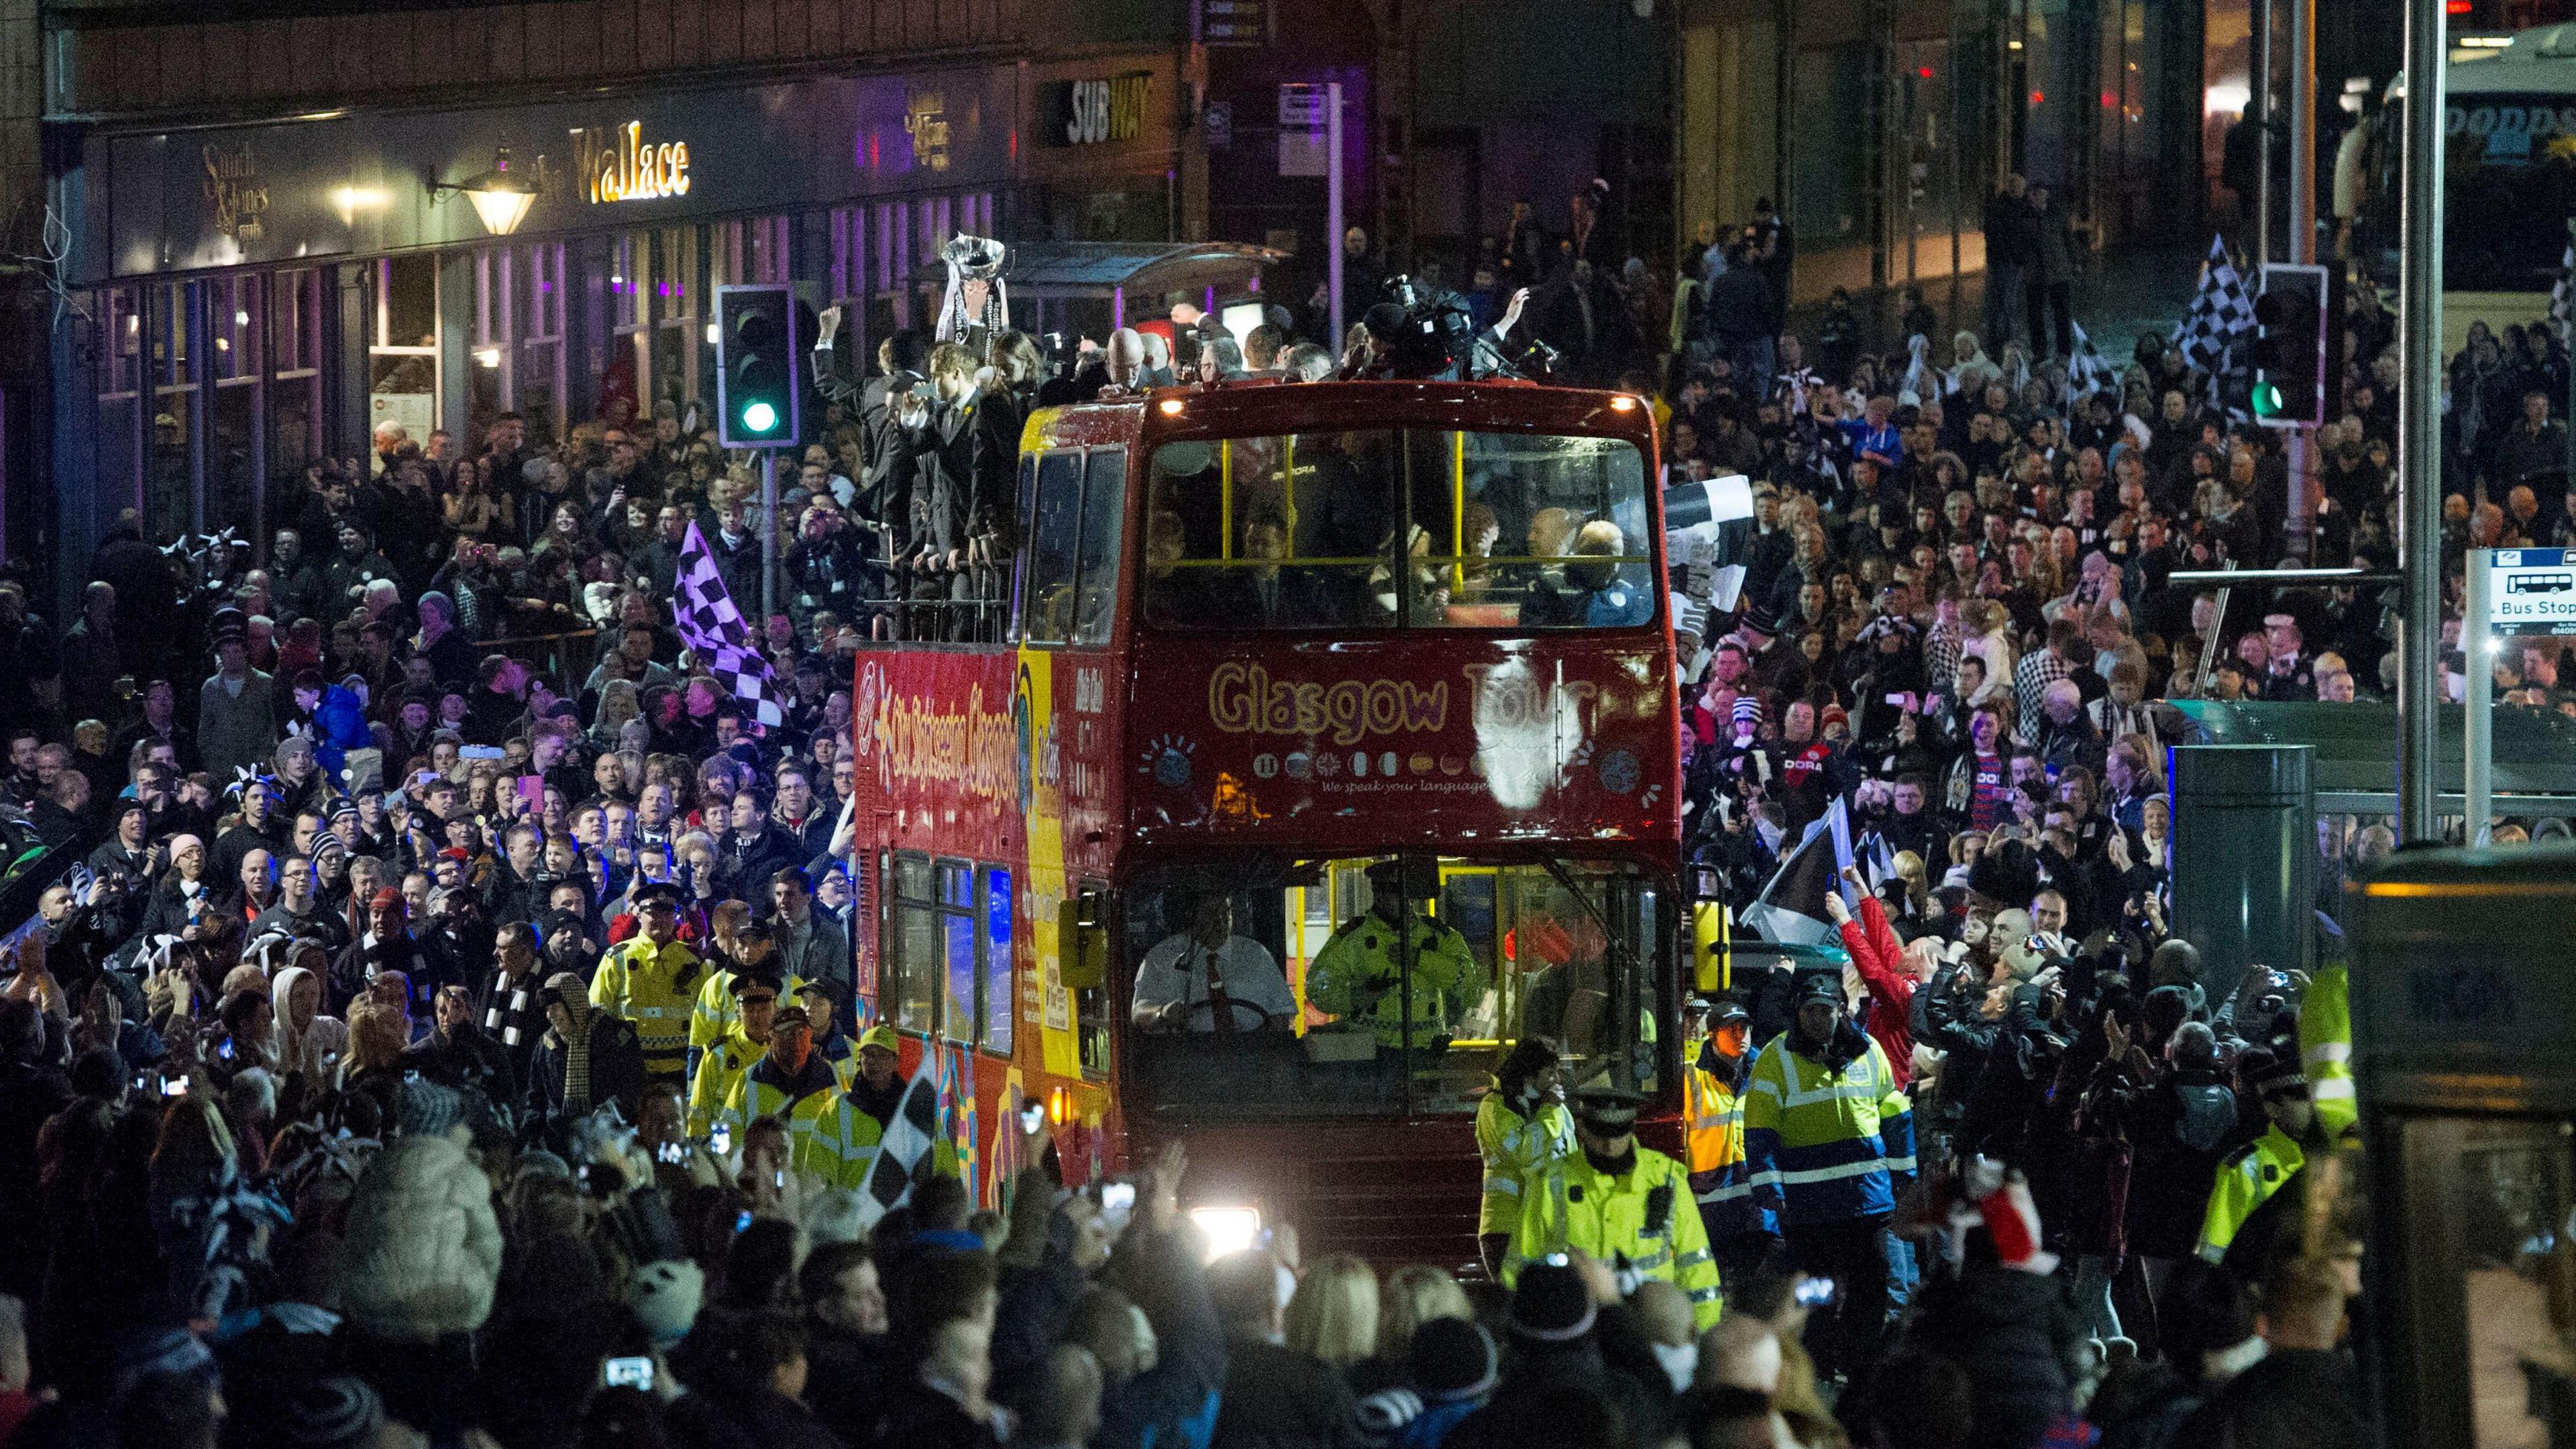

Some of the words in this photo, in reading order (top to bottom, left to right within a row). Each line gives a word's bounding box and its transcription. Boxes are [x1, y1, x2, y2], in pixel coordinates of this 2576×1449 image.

[1067, 72, 1155, 144] SUBWAY
[570, 120, 691, 204] Wallace
[2502, 602, 2532, 614] Bus
[2539, 601, 2576, 615] Stop
[1208, 661, 1448, 746] Glasgow
[969, 681, 1019, 816] Glasgow
[1322, 780, 1342, 792] We
[1346, 780, 1384, 795] speak
[1385, 782, 1417, 795] your
